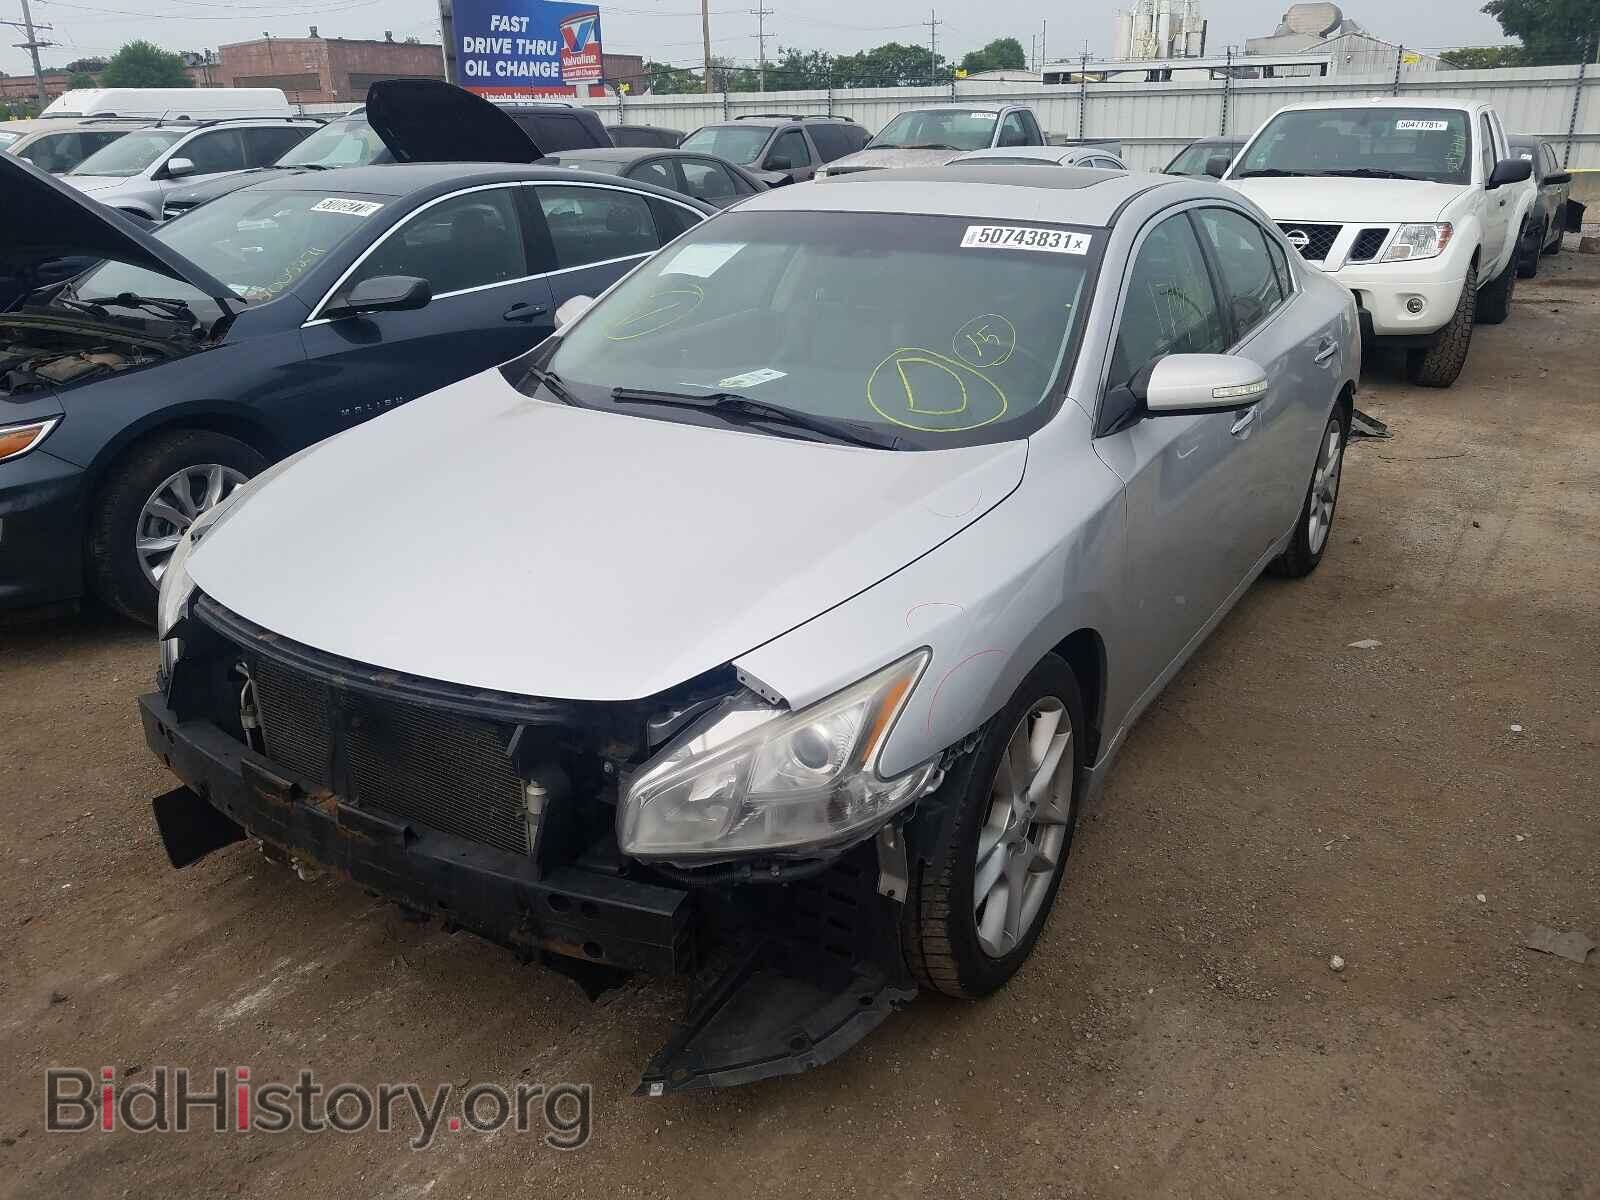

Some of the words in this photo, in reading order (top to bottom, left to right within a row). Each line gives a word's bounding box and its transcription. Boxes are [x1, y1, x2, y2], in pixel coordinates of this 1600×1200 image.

[490, 15, 529, 32] FAST
[463, 37, 512, 54] DRIVE
[516, 39, 557, 56] THRU
[562, 54, 597, 66] Valvoline
[465, 60, 491, 77] OIL
[495, 60, 559, 78] CHANGE
